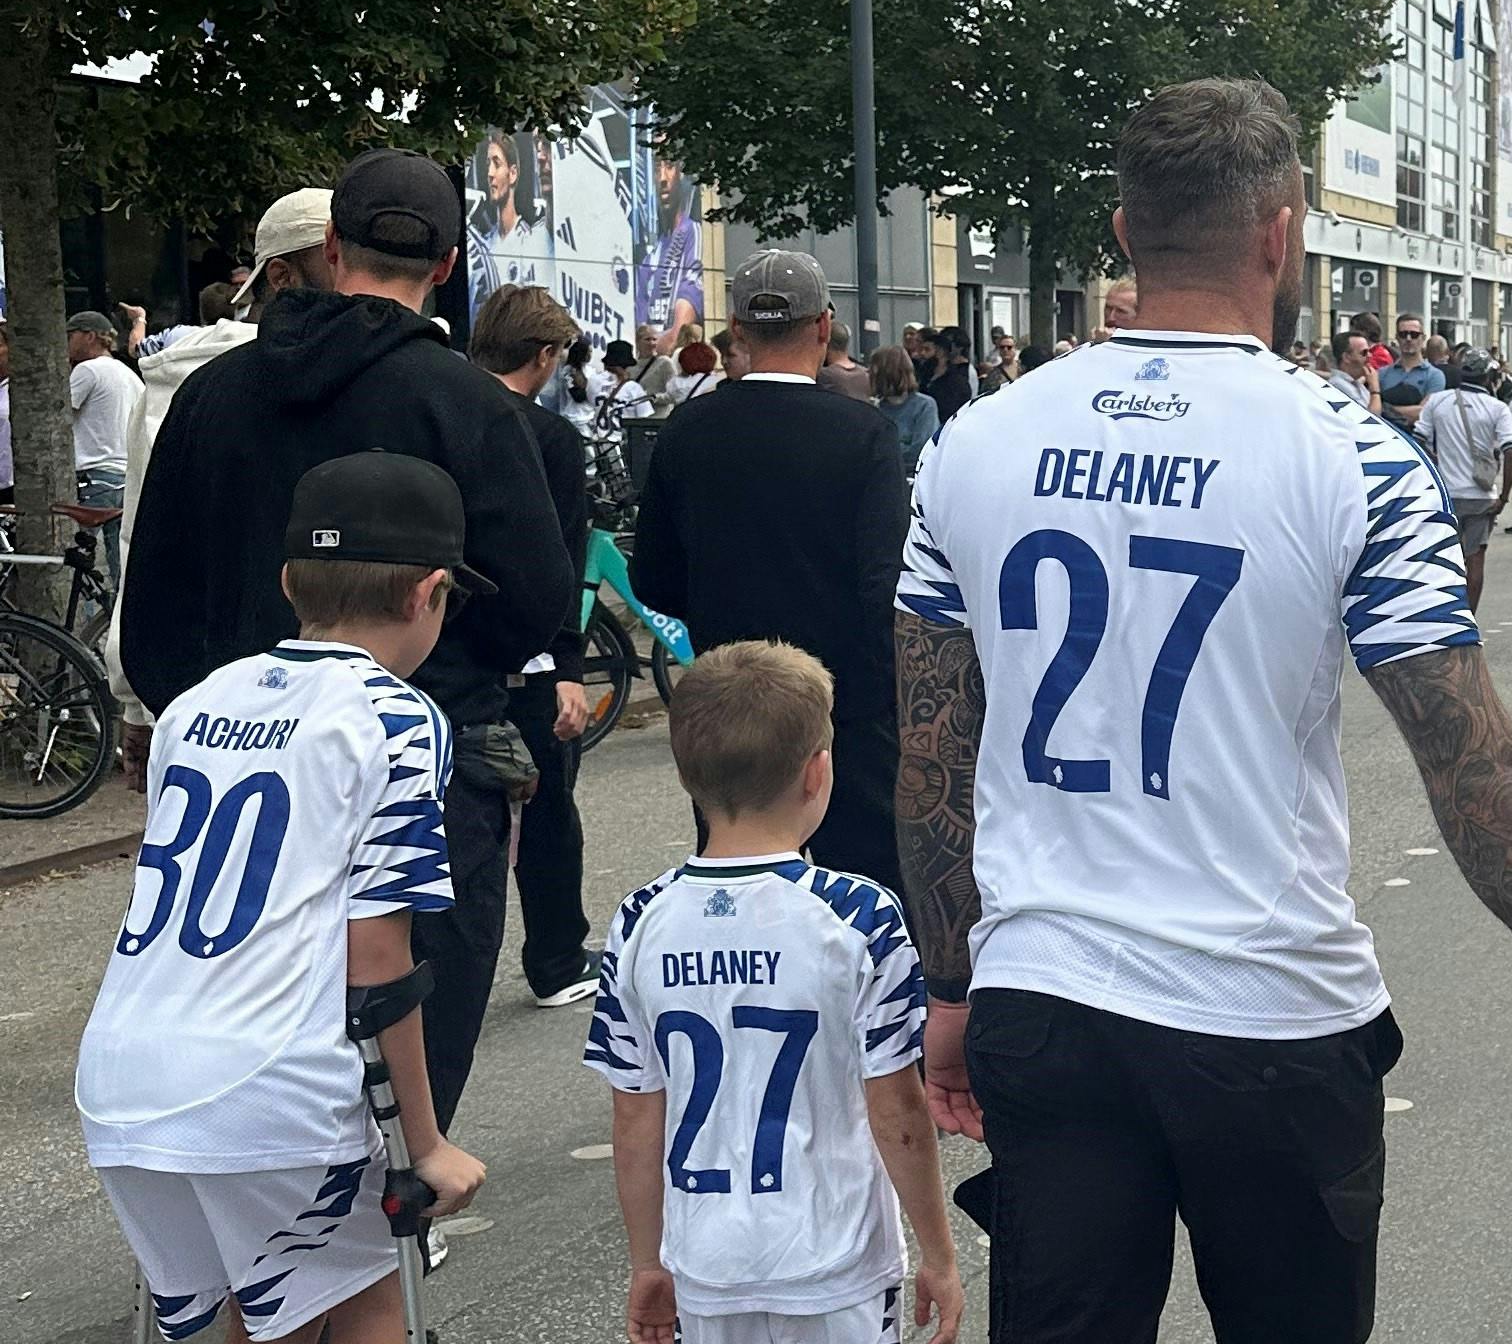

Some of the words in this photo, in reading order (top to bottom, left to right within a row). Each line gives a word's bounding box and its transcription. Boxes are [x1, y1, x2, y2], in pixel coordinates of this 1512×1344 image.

[561, 271, 625, 342] UNIBET
[1091, 389, 1192, 422] Carlsberg
[1033, 448, 1221, 509] DELANEY
[998, 528, 1246, 801] 27
[182, 711, 301, 751] ACHOURI
[115, 764, 291, 959] 30
[661, 949, 782, 988] DELANEY
[654, 1005, 819, 1195] 27
